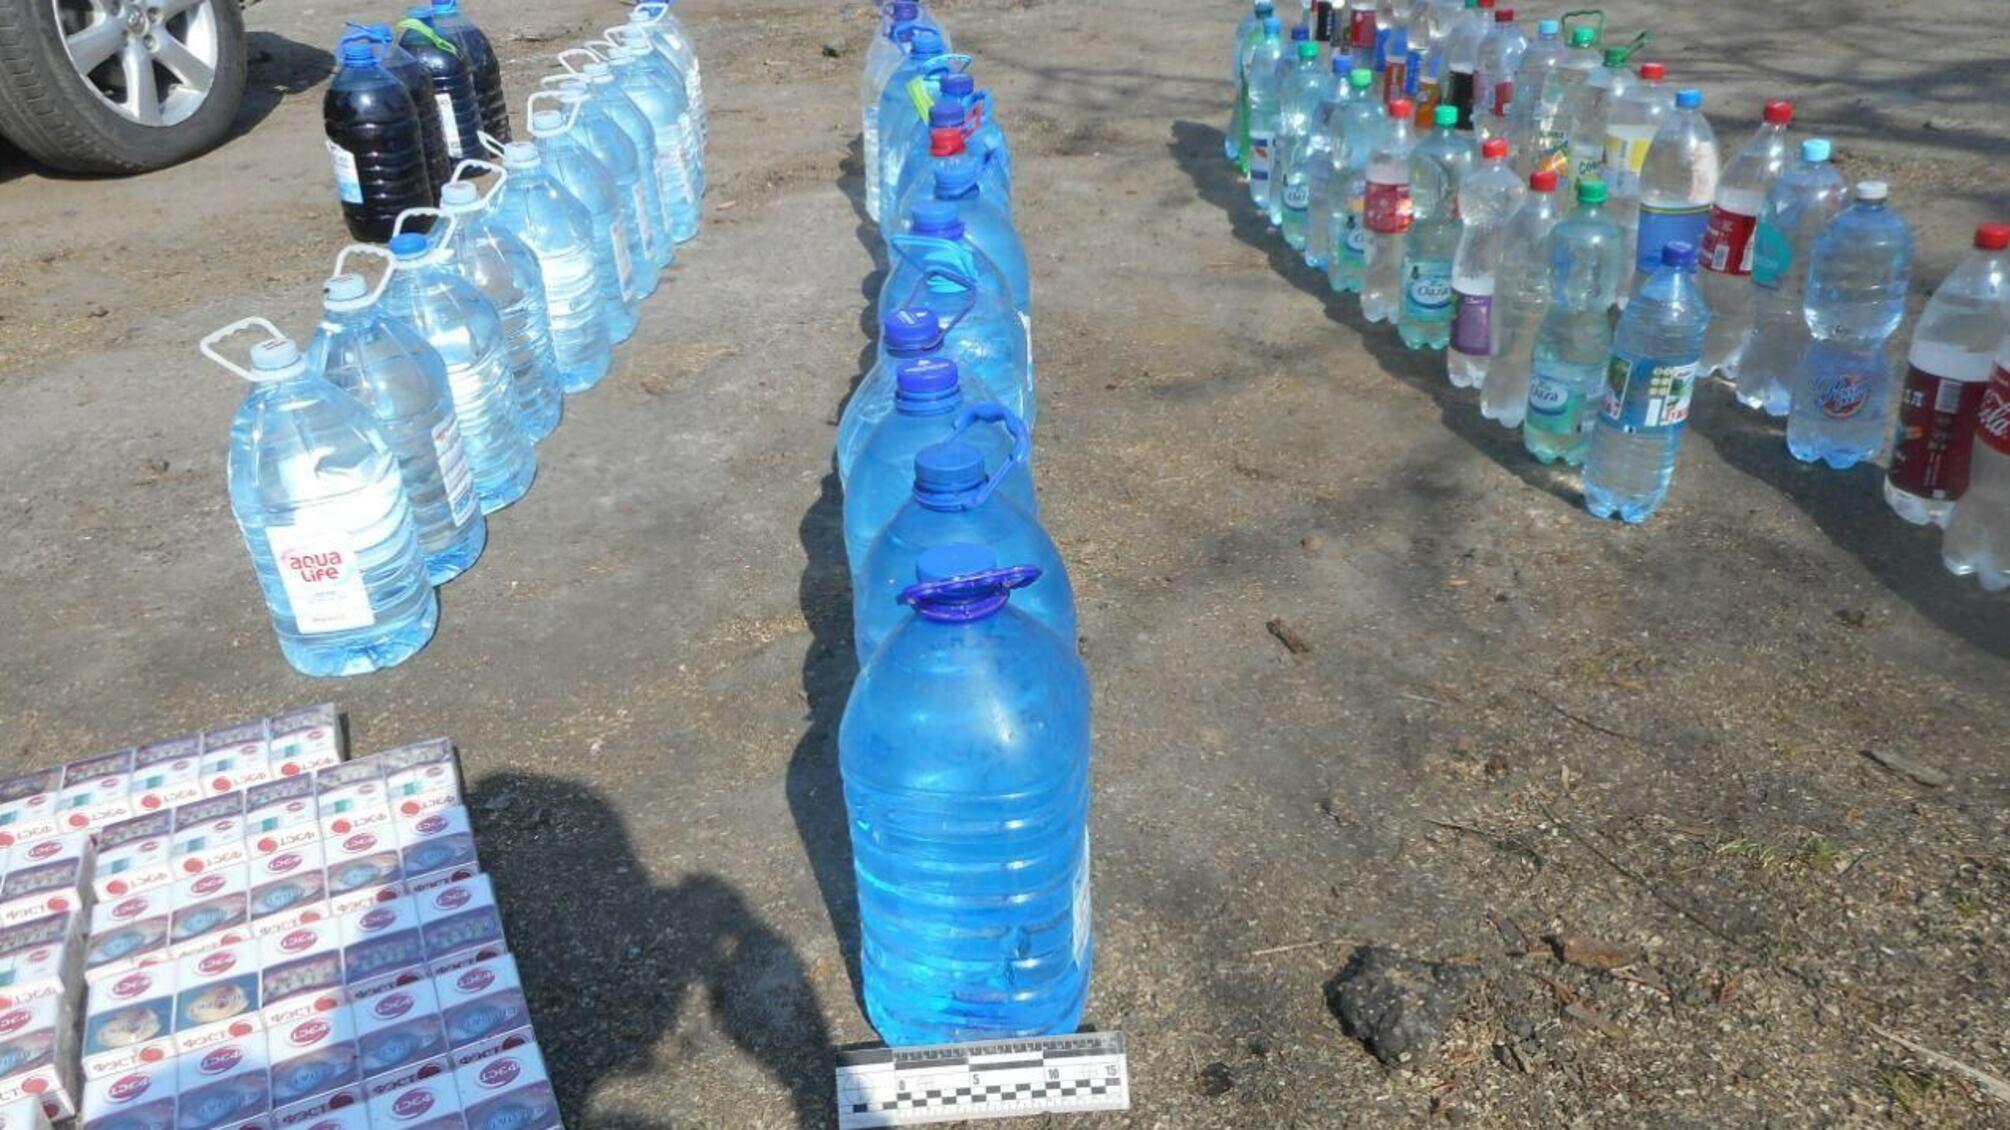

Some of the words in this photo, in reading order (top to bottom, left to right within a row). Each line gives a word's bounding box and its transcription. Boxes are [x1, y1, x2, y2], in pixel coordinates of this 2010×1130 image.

[290, 551, 342, 570] aqua
[972, 1073, 981, 1085] 5
[1048, 1068, 1060, 1080] 10
[1105, 1064, 1118, 1077] 15
